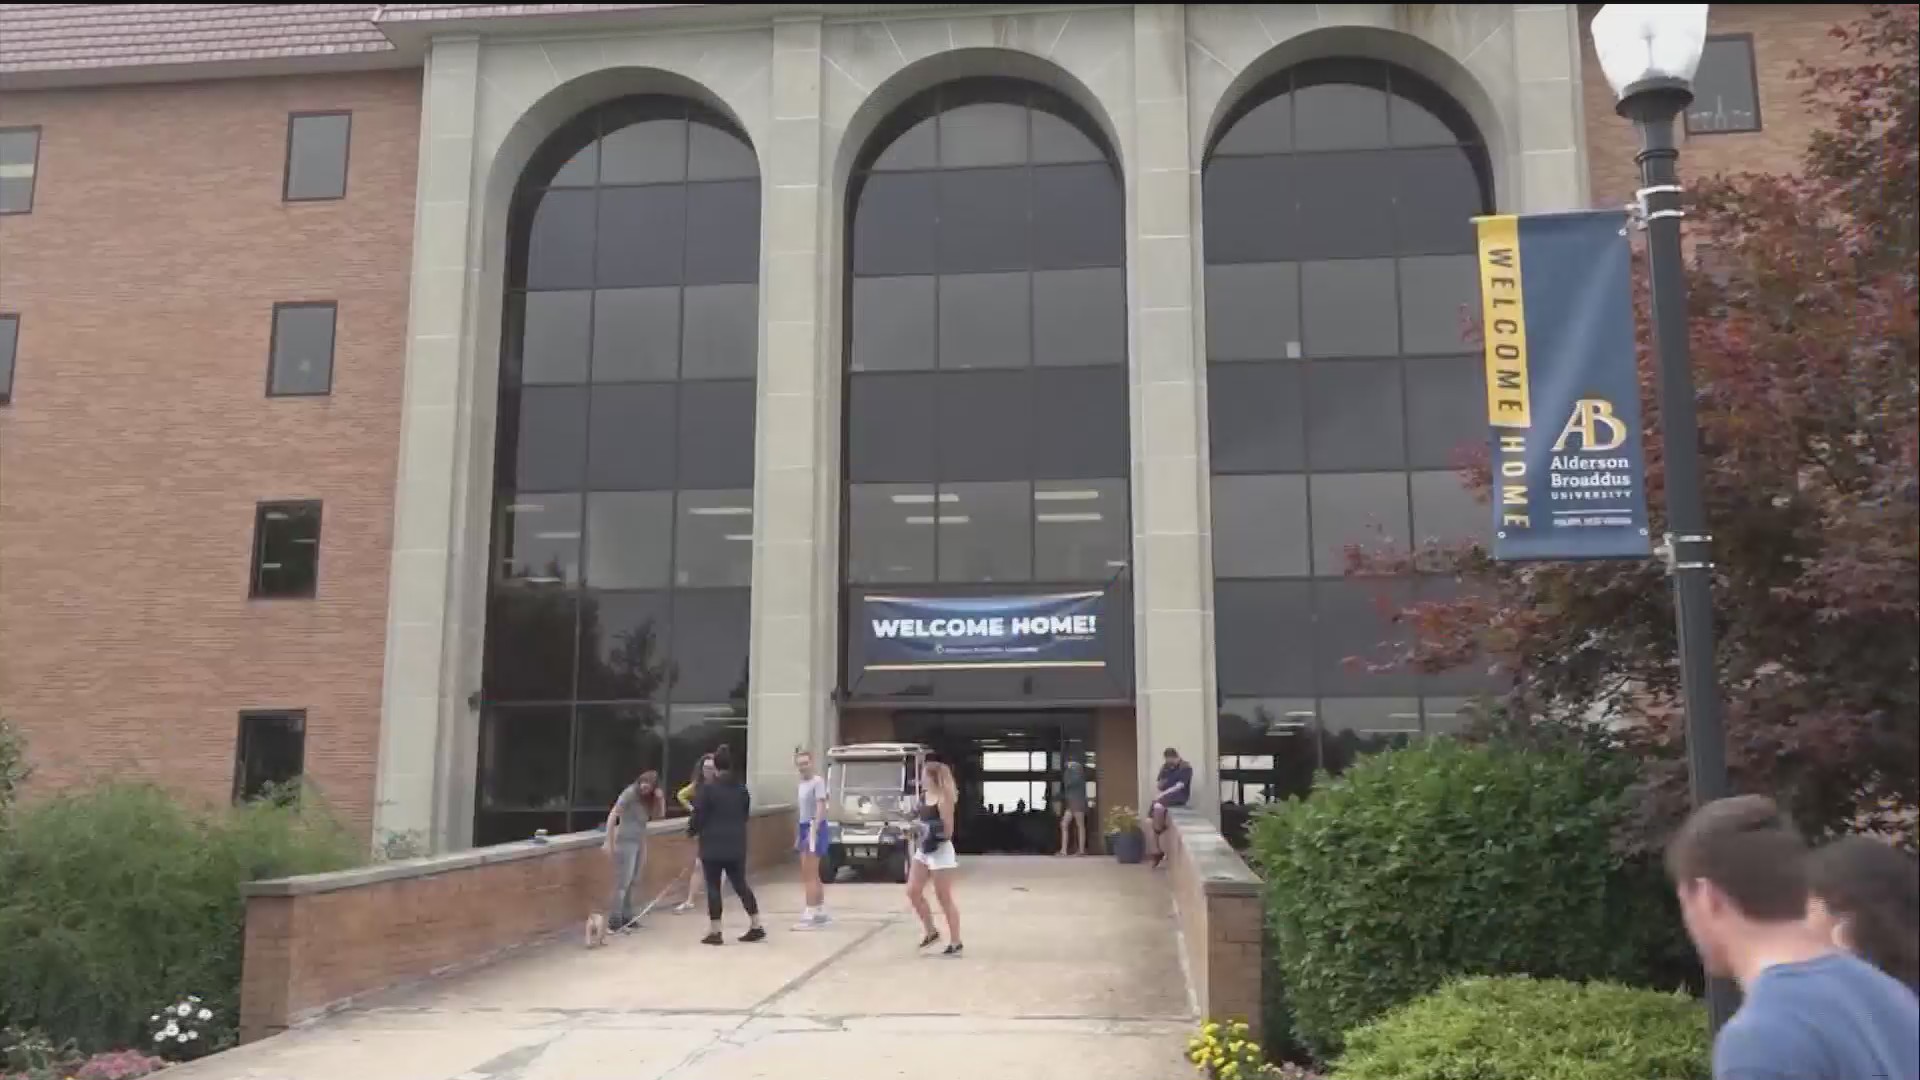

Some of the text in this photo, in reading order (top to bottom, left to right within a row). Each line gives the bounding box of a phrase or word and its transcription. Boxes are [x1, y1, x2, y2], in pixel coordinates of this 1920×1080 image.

[1488, 248, 1530, 528] WELCOME HOME
[1550, 399, 1627, 451] AB
[1551, 456, 1629, 470] Alderson
[1551, 472, 1632, 487] Broaddus
[1551, 490, 1632, 500] UNIVERSITY
[872, 615, 1097, 638] WELCOME HOME!
